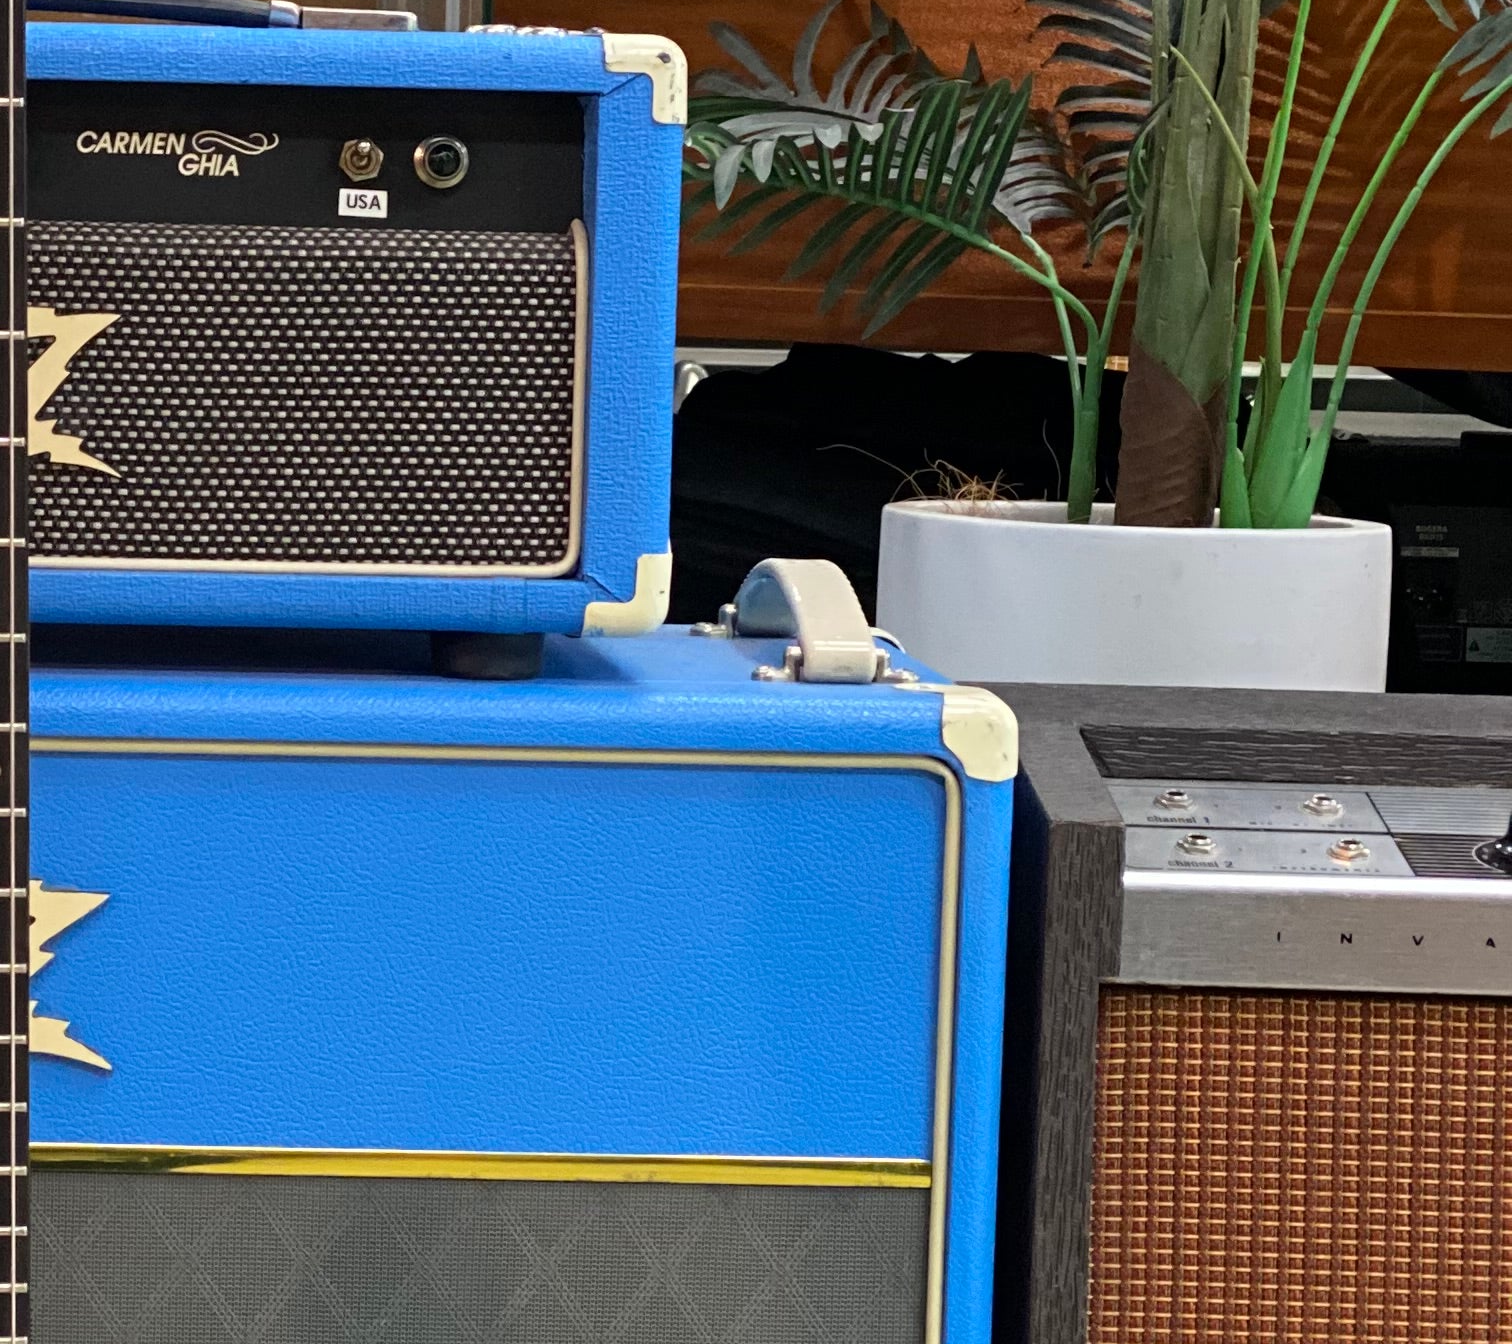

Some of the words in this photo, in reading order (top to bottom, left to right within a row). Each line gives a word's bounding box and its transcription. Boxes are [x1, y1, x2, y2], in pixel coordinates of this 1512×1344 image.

[76, 131, 186, 155] CARMEN
[178, 153, 239, 176] GHIA
[346, 193, 381, 210] USA
[1146, 815, 1197, 825] channel
[1202, 816, 1210, 825] 1
[1167, 859, 1219, 869] channel
[1225, 860, 1233, 869] 2
